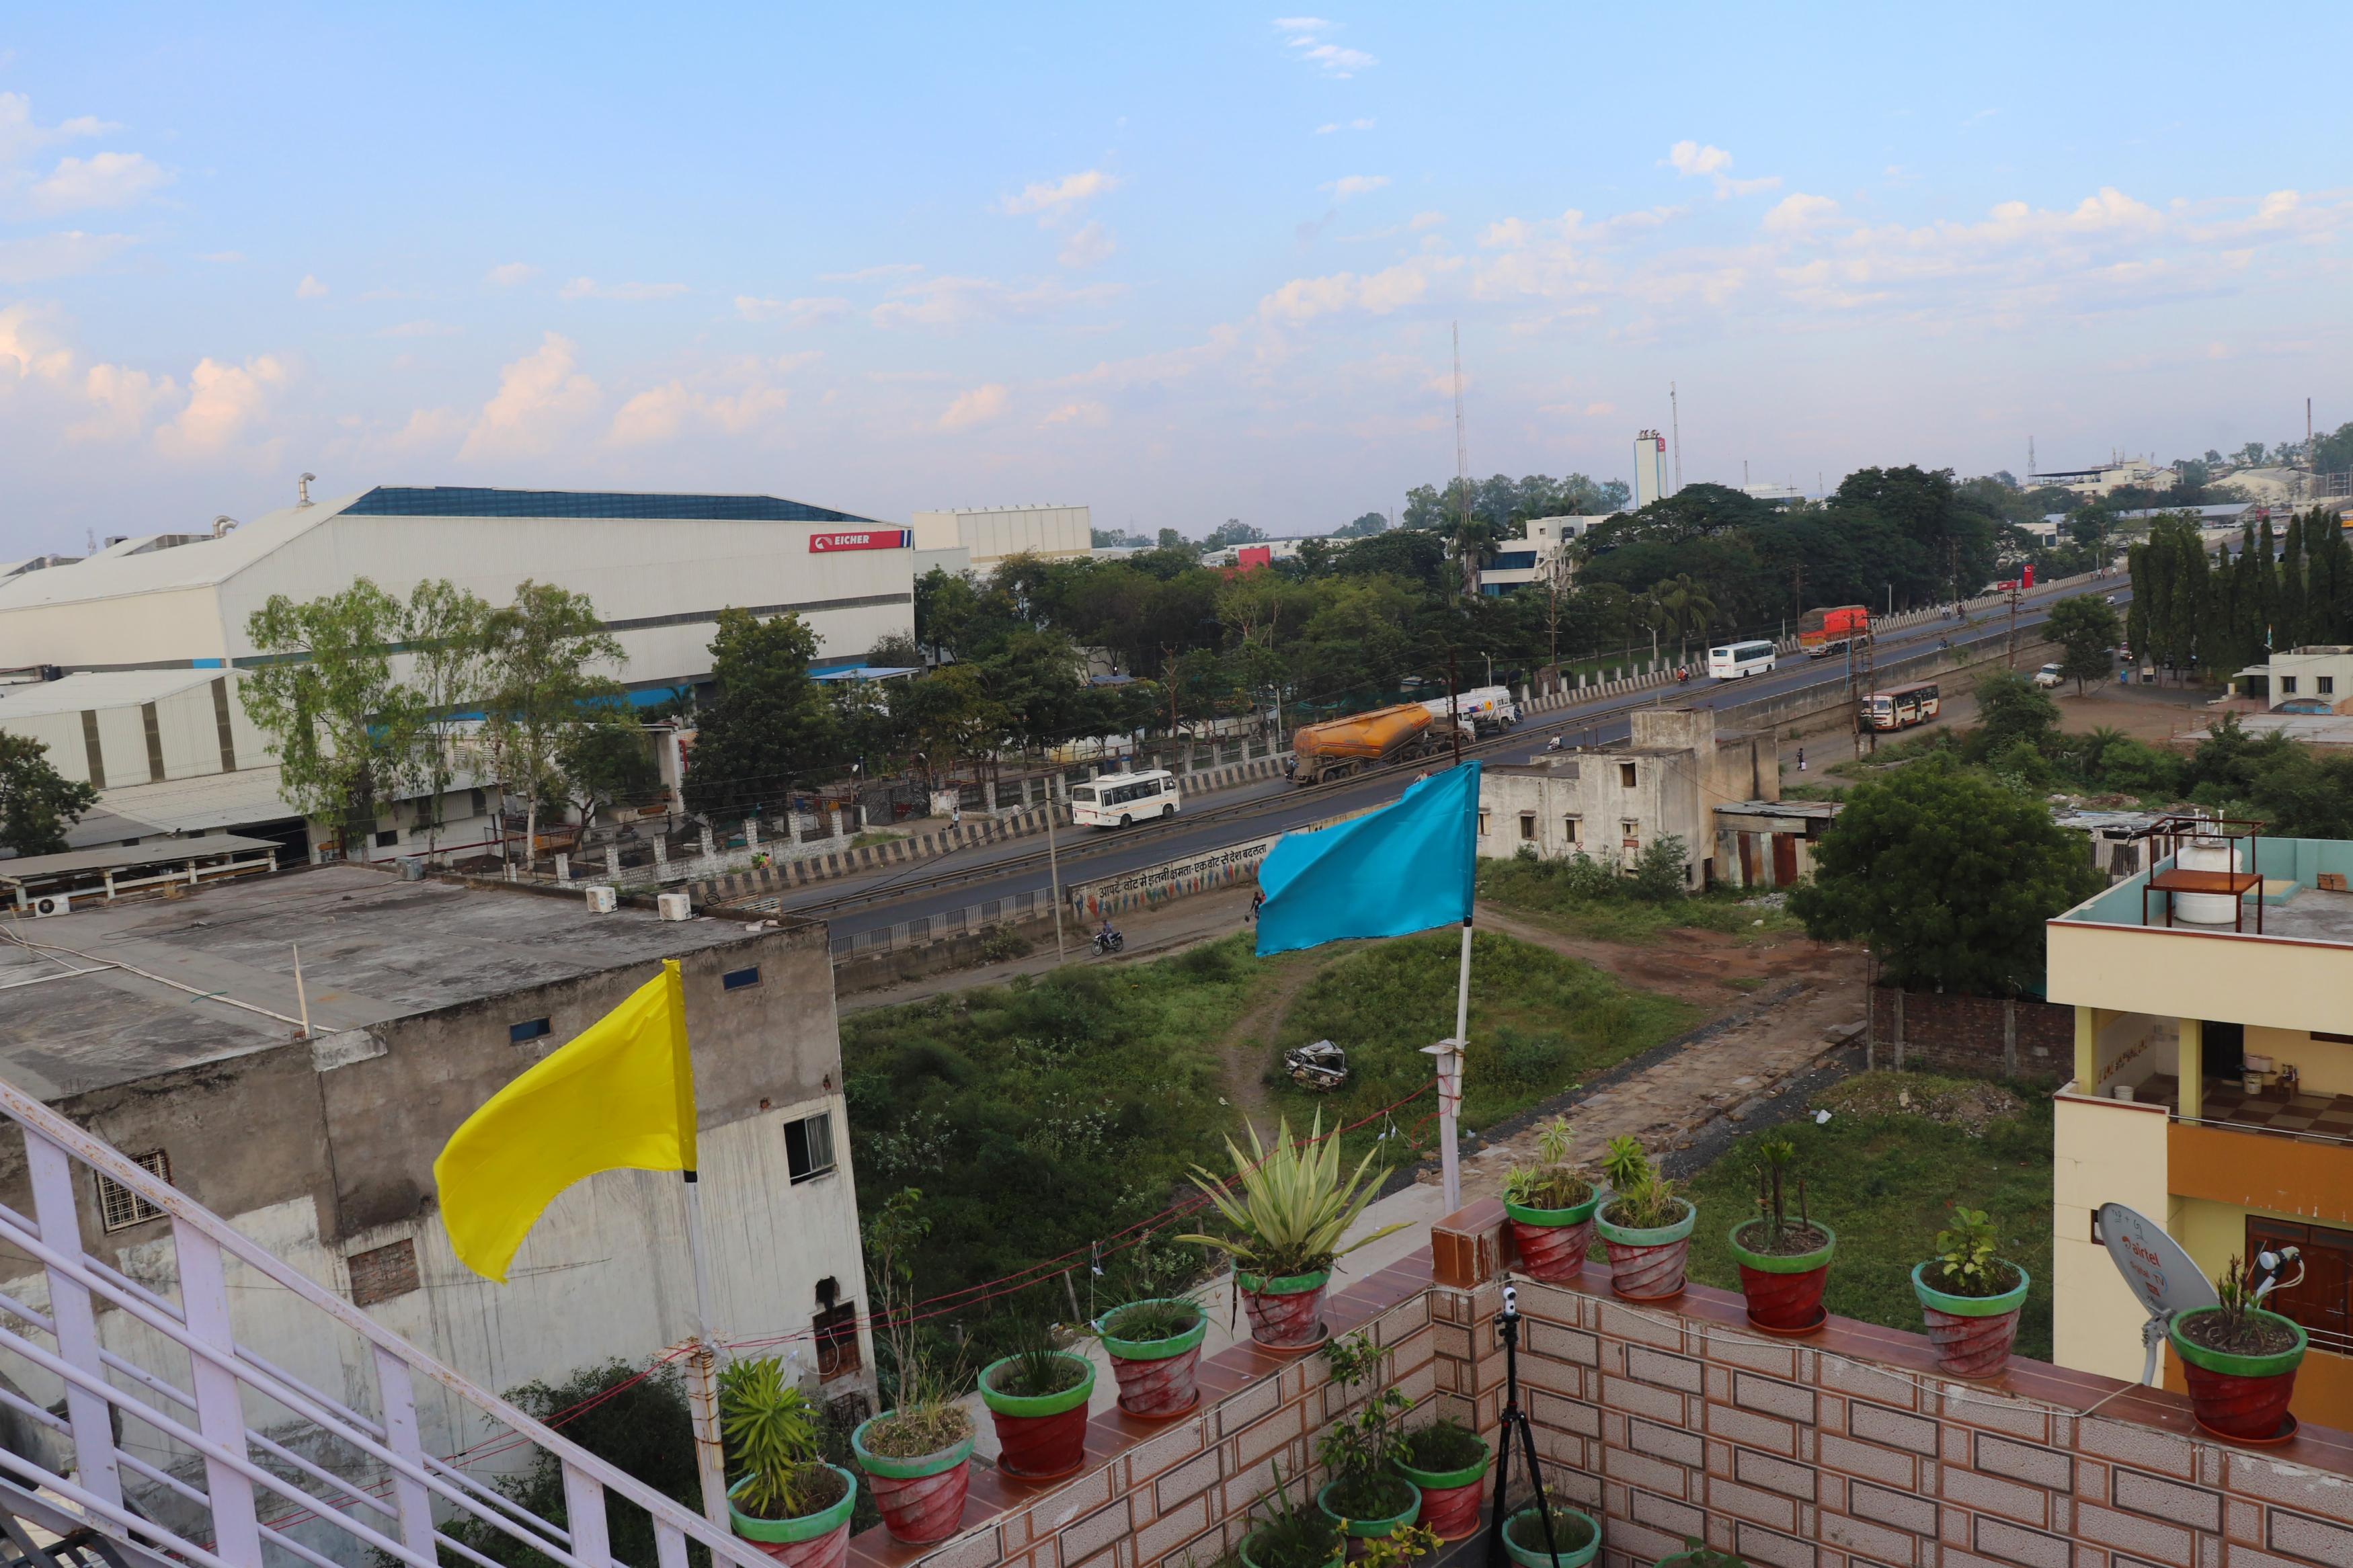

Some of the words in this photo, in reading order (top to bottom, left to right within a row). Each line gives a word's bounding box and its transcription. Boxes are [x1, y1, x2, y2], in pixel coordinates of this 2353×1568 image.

[834, 535, 869, 545] EICHER
[1123, 877, 1139, 891] वोट
[1148, 868, 1169, 886] इतनी
[1207, 856, 1220, 868] वोट
[1220, 852, 1229, 865] से
[1230, 850, 1242, 862] देश
[1242, 843, 1267, 858] बदलता
[2132, 1243, 2161, 1268] airtel
[2153, 1274, 2165, 1286] TV
